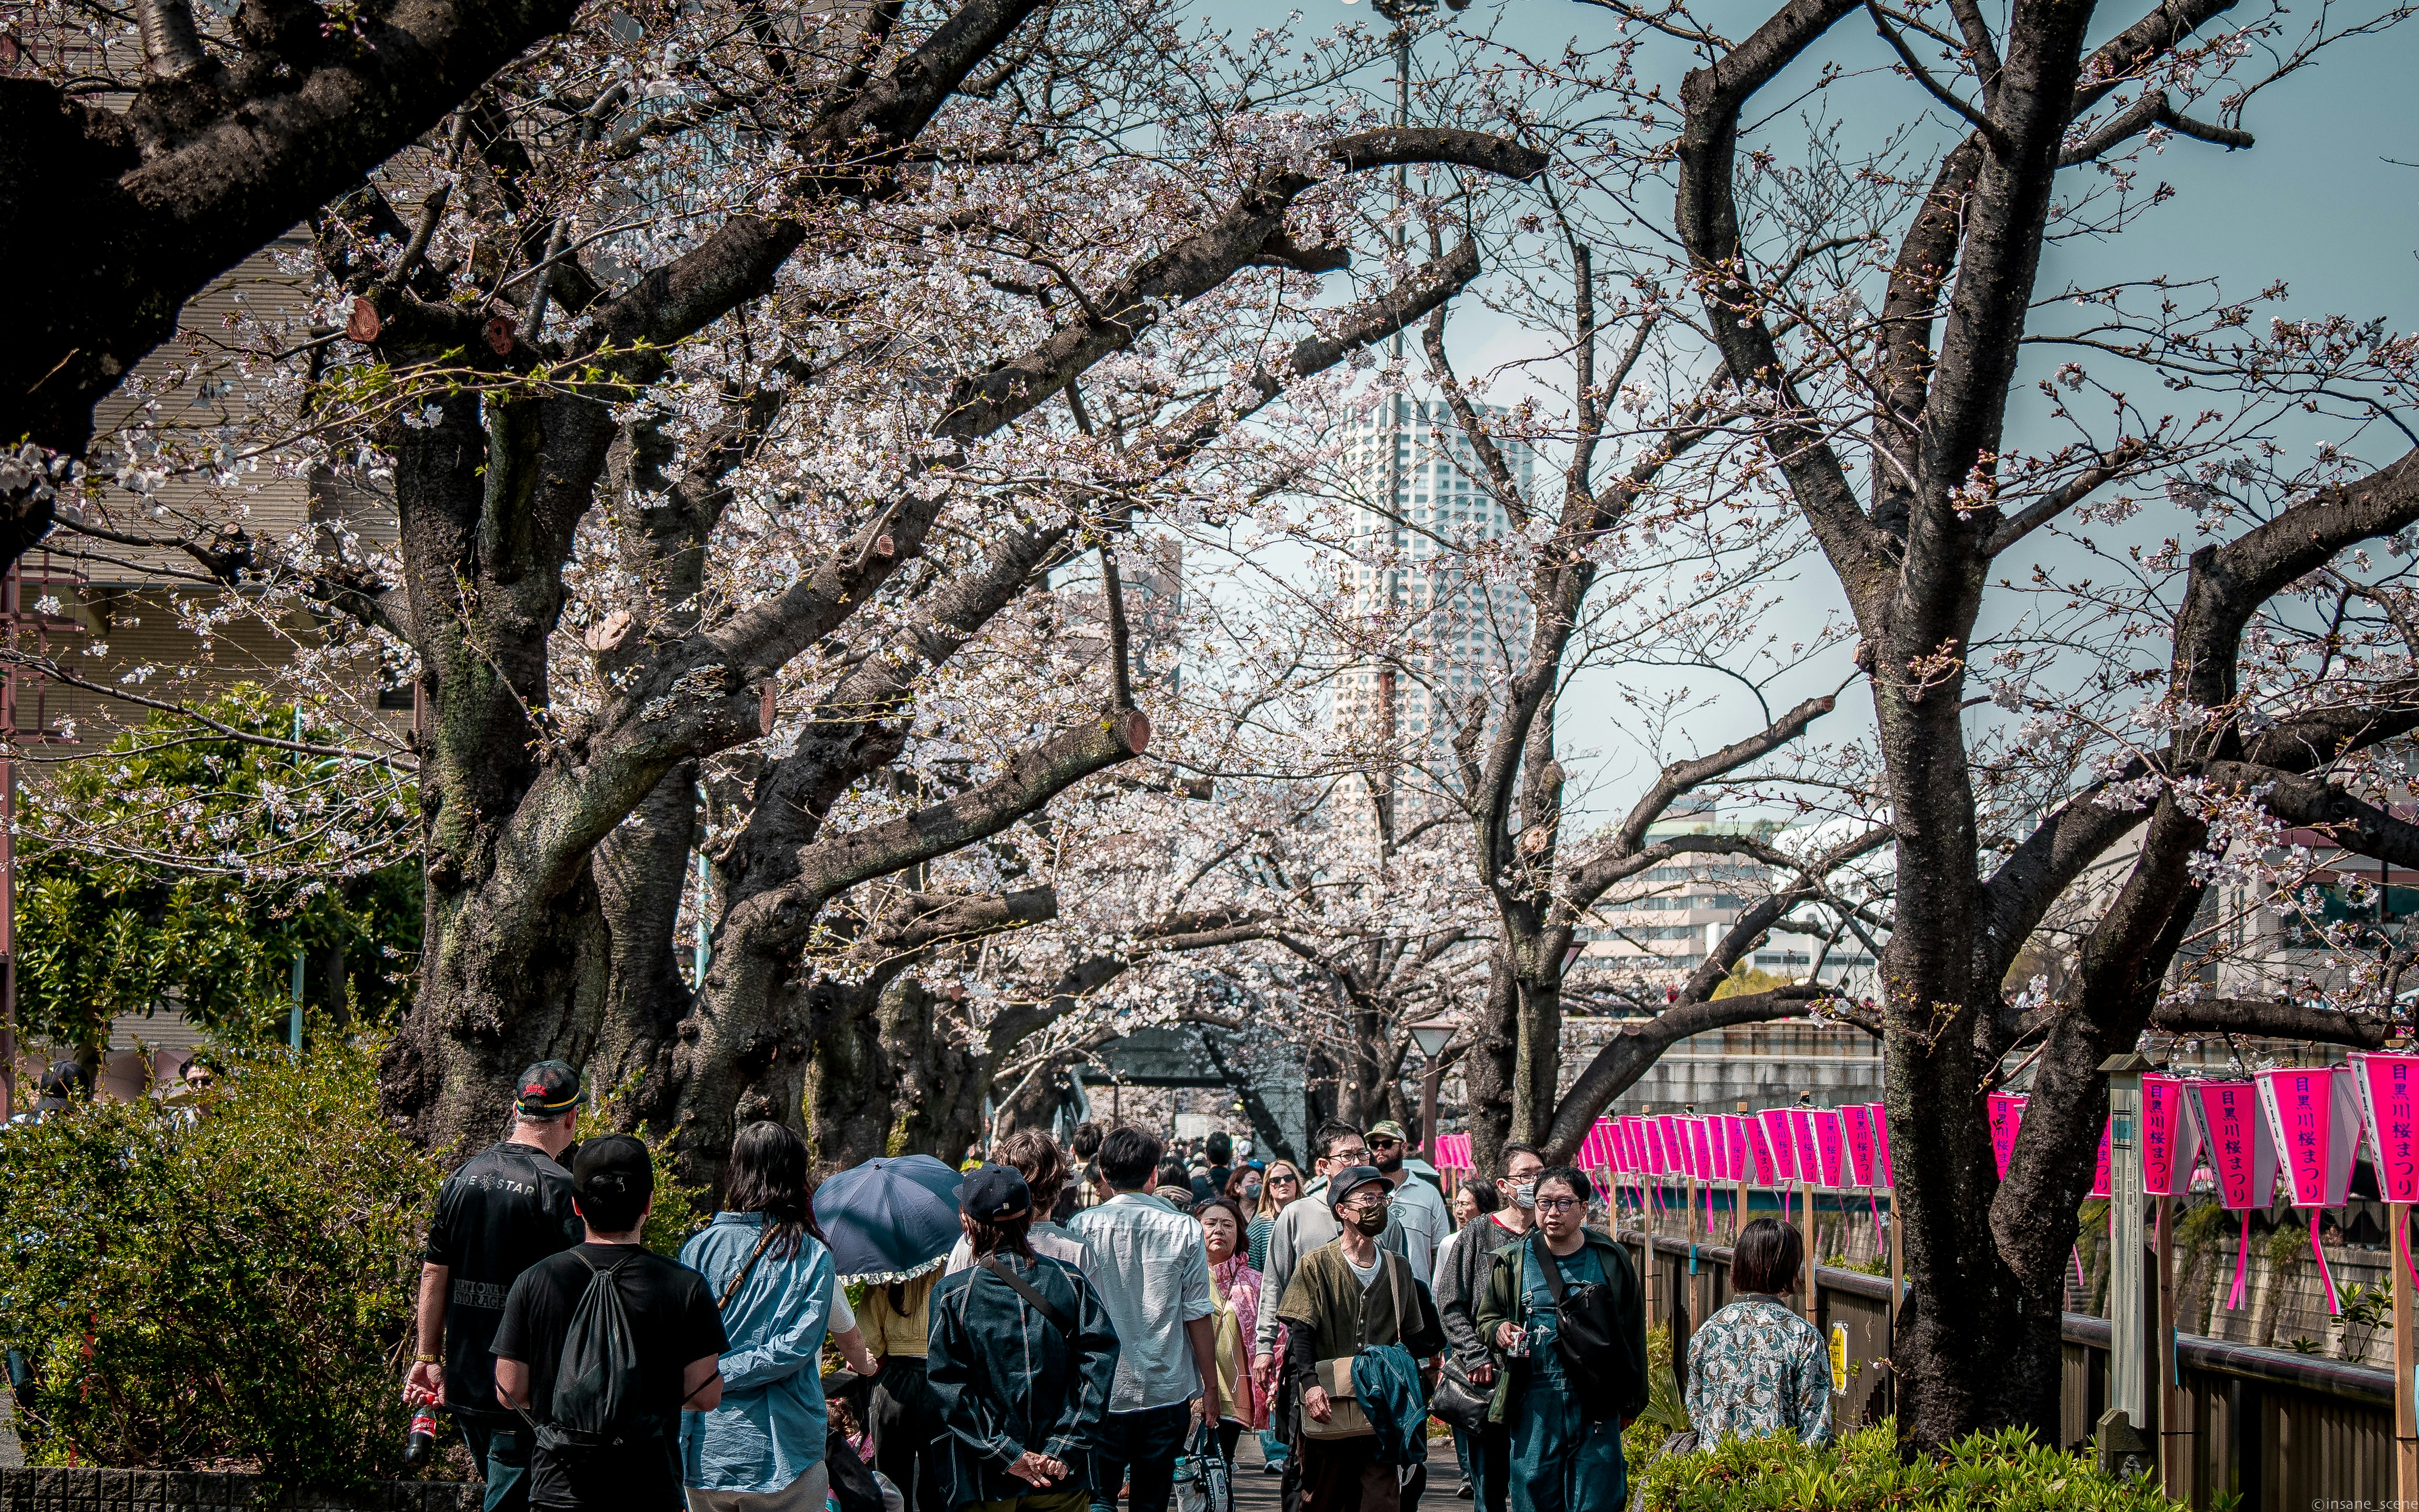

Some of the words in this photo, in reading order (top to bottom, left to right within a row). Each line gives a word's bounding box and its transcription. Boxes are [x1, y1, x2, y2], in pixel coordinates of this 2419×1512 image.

[1733, 1120, 1741, 1179] 目黒川桜まつり
[1775, 1113, 1791, 1176] 目黒川桜まつり
[1803, 1114, 1814, 1180] 目黒川桜まつり
[1826, 1115, 1837, 1184] 目黒川桜まつり
[1856, 1110, 1869, 1182] 目黒川桜まつり
[1996, 1101, 2009, 1169] 目黒川桜ま
[2097, 1125, 2109, 1191] 桜まつり
[2149, 1085, 2166, 1189] 目黒川桜まつり
[2221, 1090, 2246, 1202] 目黒川桜まつり
[2295, 1076, 2319, 1199] 目黒川桜まつり
[2391, 1064, 2413, 1195] 目黒川桜まつり
[454, 1175, 478, 1187] THE
[497, 1179, 534, 1196] STAR
[454, 1279, 507, 1297] NATIONAL
[454, 1291, 506, 1308] STORAGE
